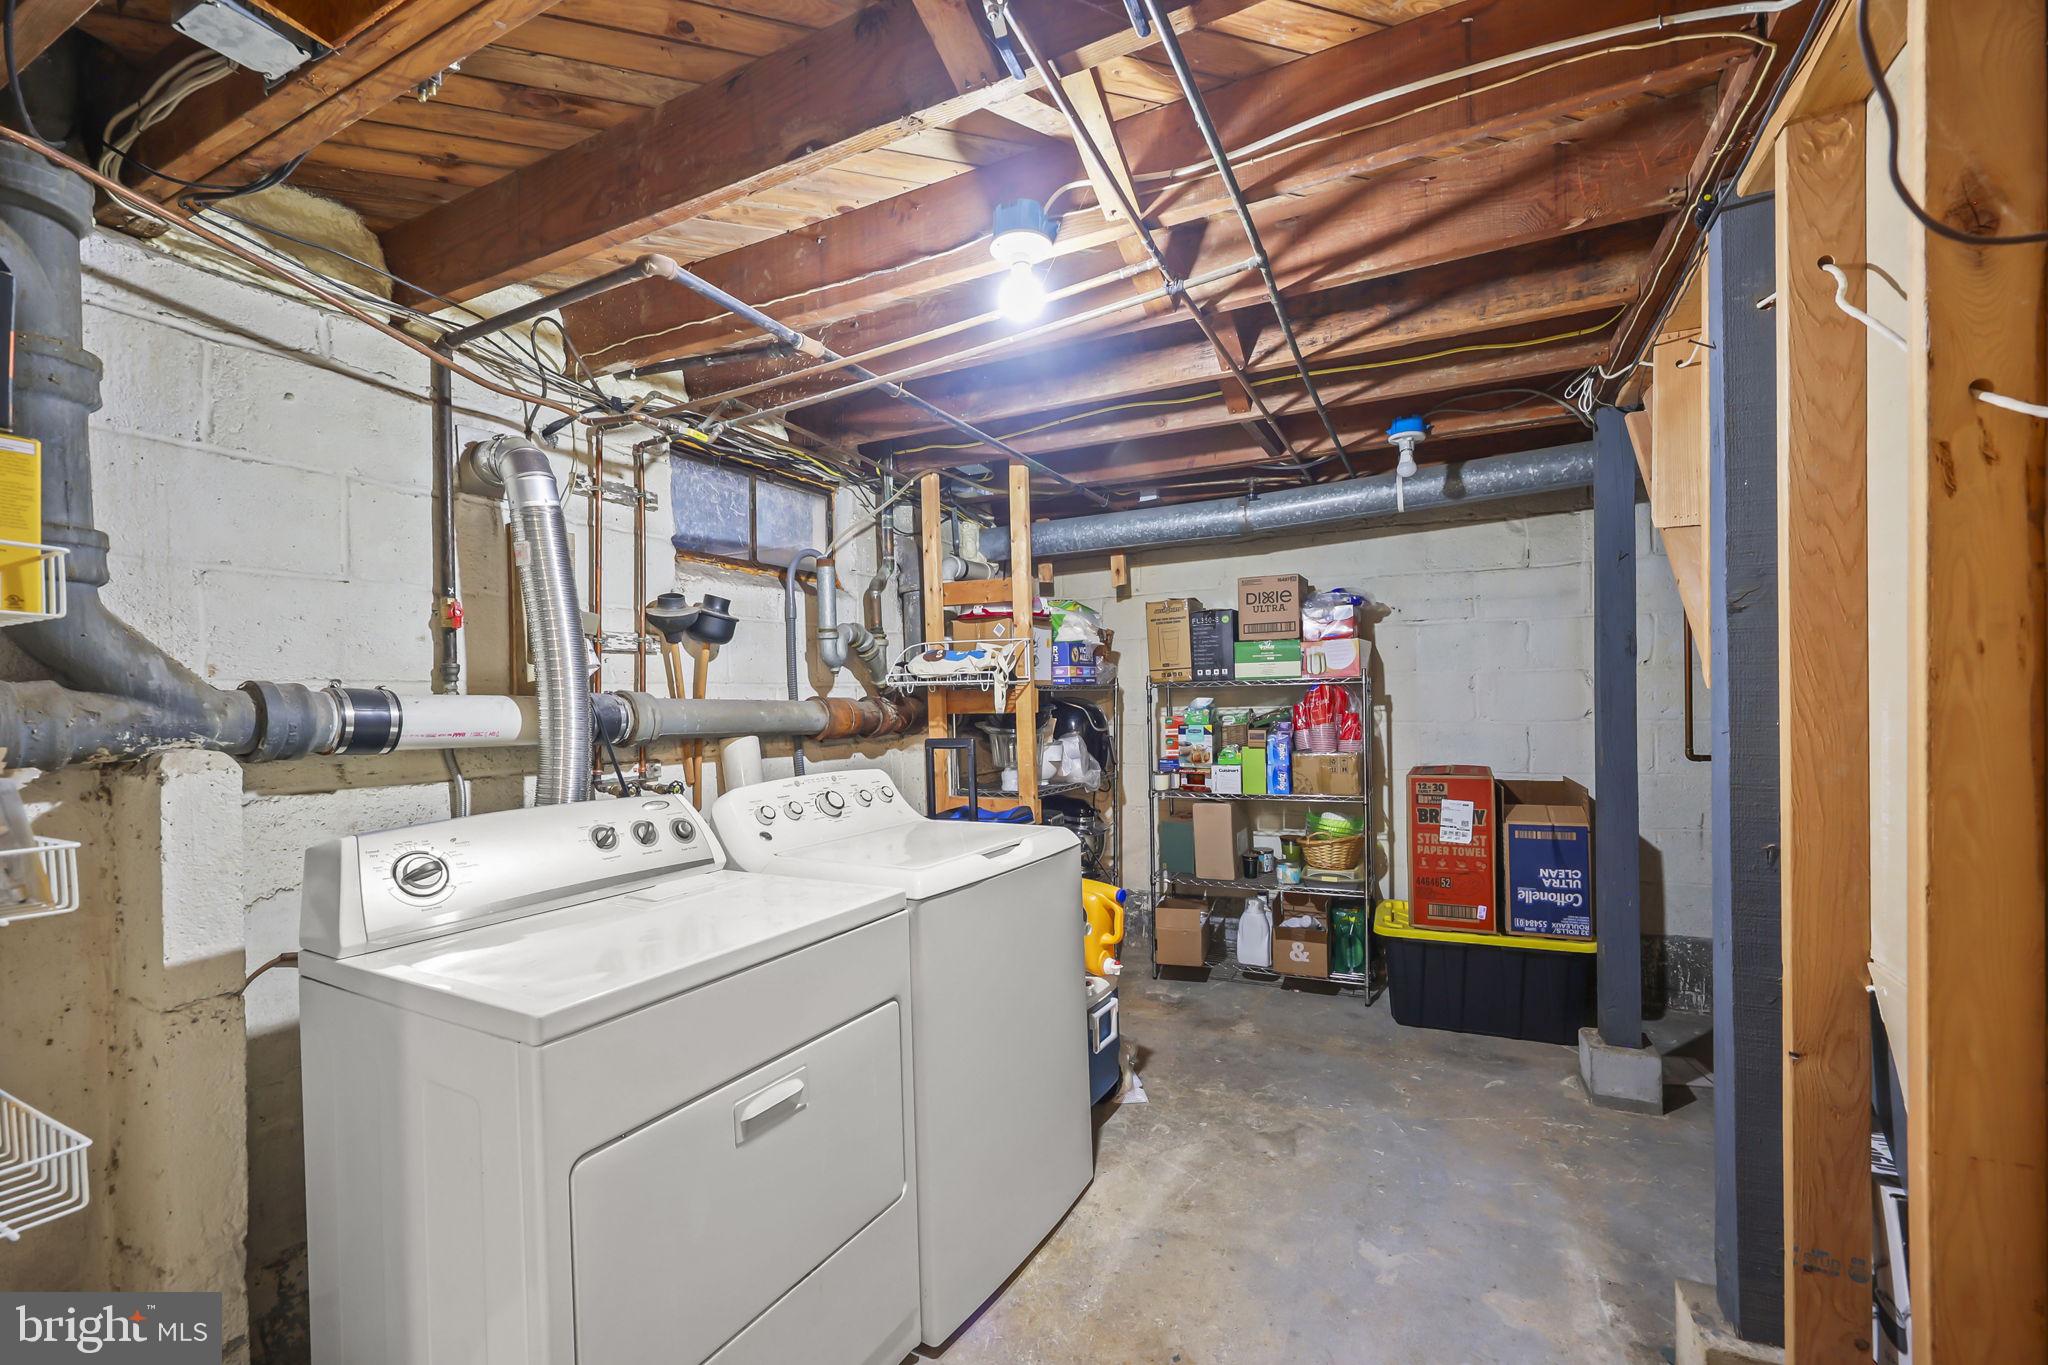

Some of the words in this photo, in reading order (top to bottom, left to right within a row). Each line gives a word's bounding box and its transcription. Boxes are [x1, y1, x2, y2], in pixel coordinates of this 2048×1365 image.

[1252, 604, 1286, 613] ULTRA
[1432, 783, 1445, 792] 30
[1417, 833, 1487, 847] STRST
[1417, 845, 1449, 856] PAPER
[1452, 847, 1487, 857] TOWEL
[1539, 868, 1582, 879] CLEAN
[1542, 878, 1582, 889] ULTRA
[1518, 890, 1583, 907] Cottonelle
[1552, 922, 1590, 930] ROULEAUX
[1289, 941, 1310, 962] &
